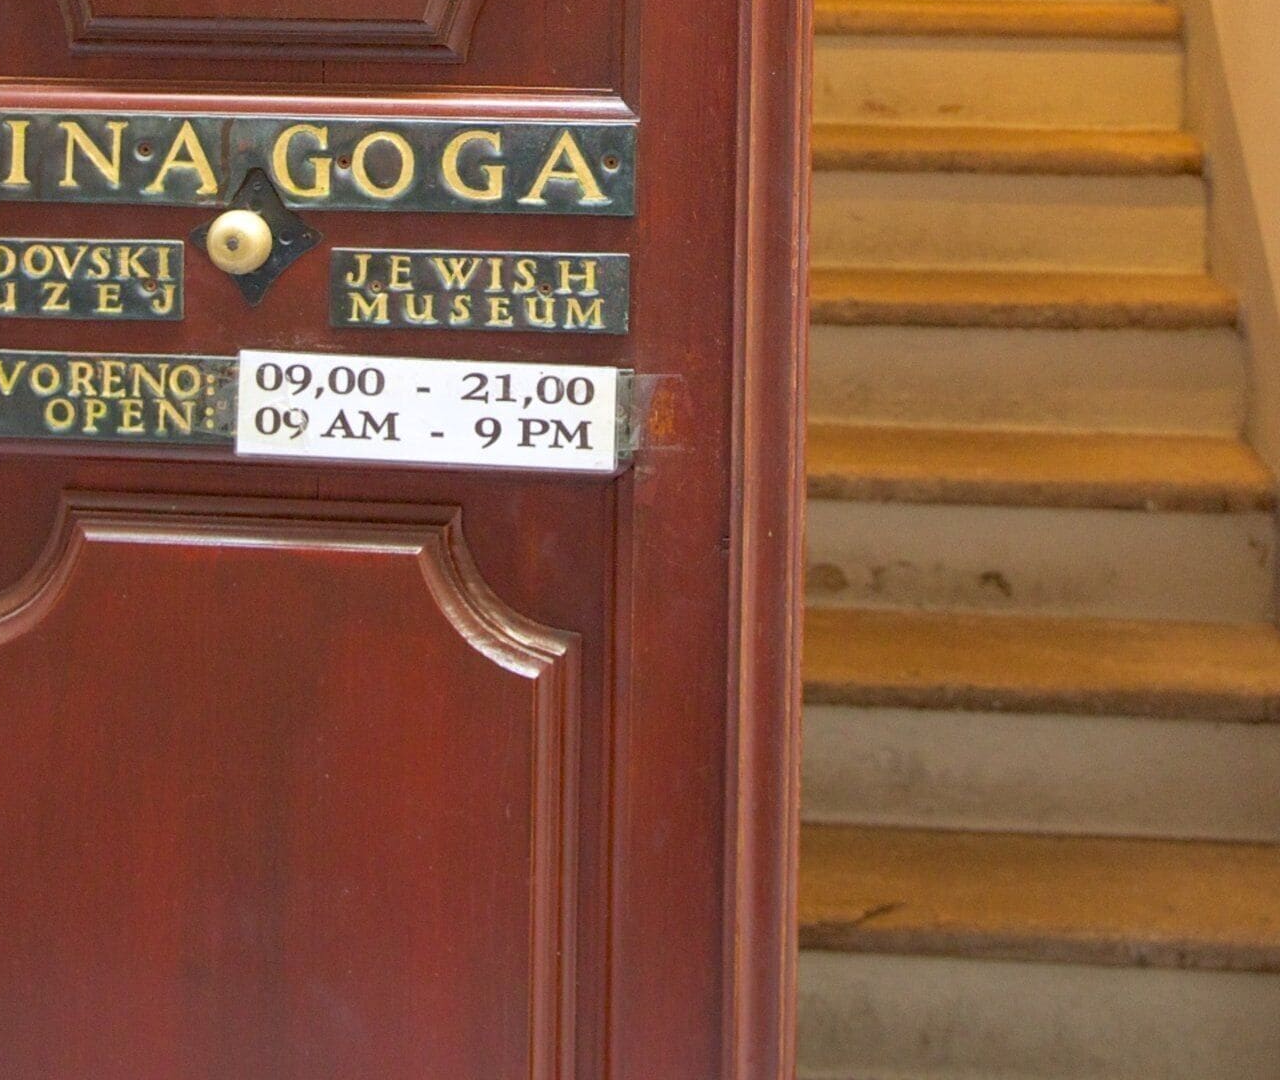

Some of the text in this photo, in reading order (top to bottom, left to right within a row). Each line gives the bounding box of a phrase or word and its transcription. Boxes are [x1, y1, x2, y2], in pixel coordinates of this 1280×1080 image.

[345, 253, 599, 295] JEWISH
[347, 292, 606, 329] MUSEUM
[255, 363, 385, 398] 09,00
[460, 373, 595, 409] 21,00
[45, 397, 216, 435] OPEN:
[255, 407, 309, 439] 09
[320, 410, 401, 441] AM
[474, 417, 502, 449] 9
[517, 418, 594, 450] PM
